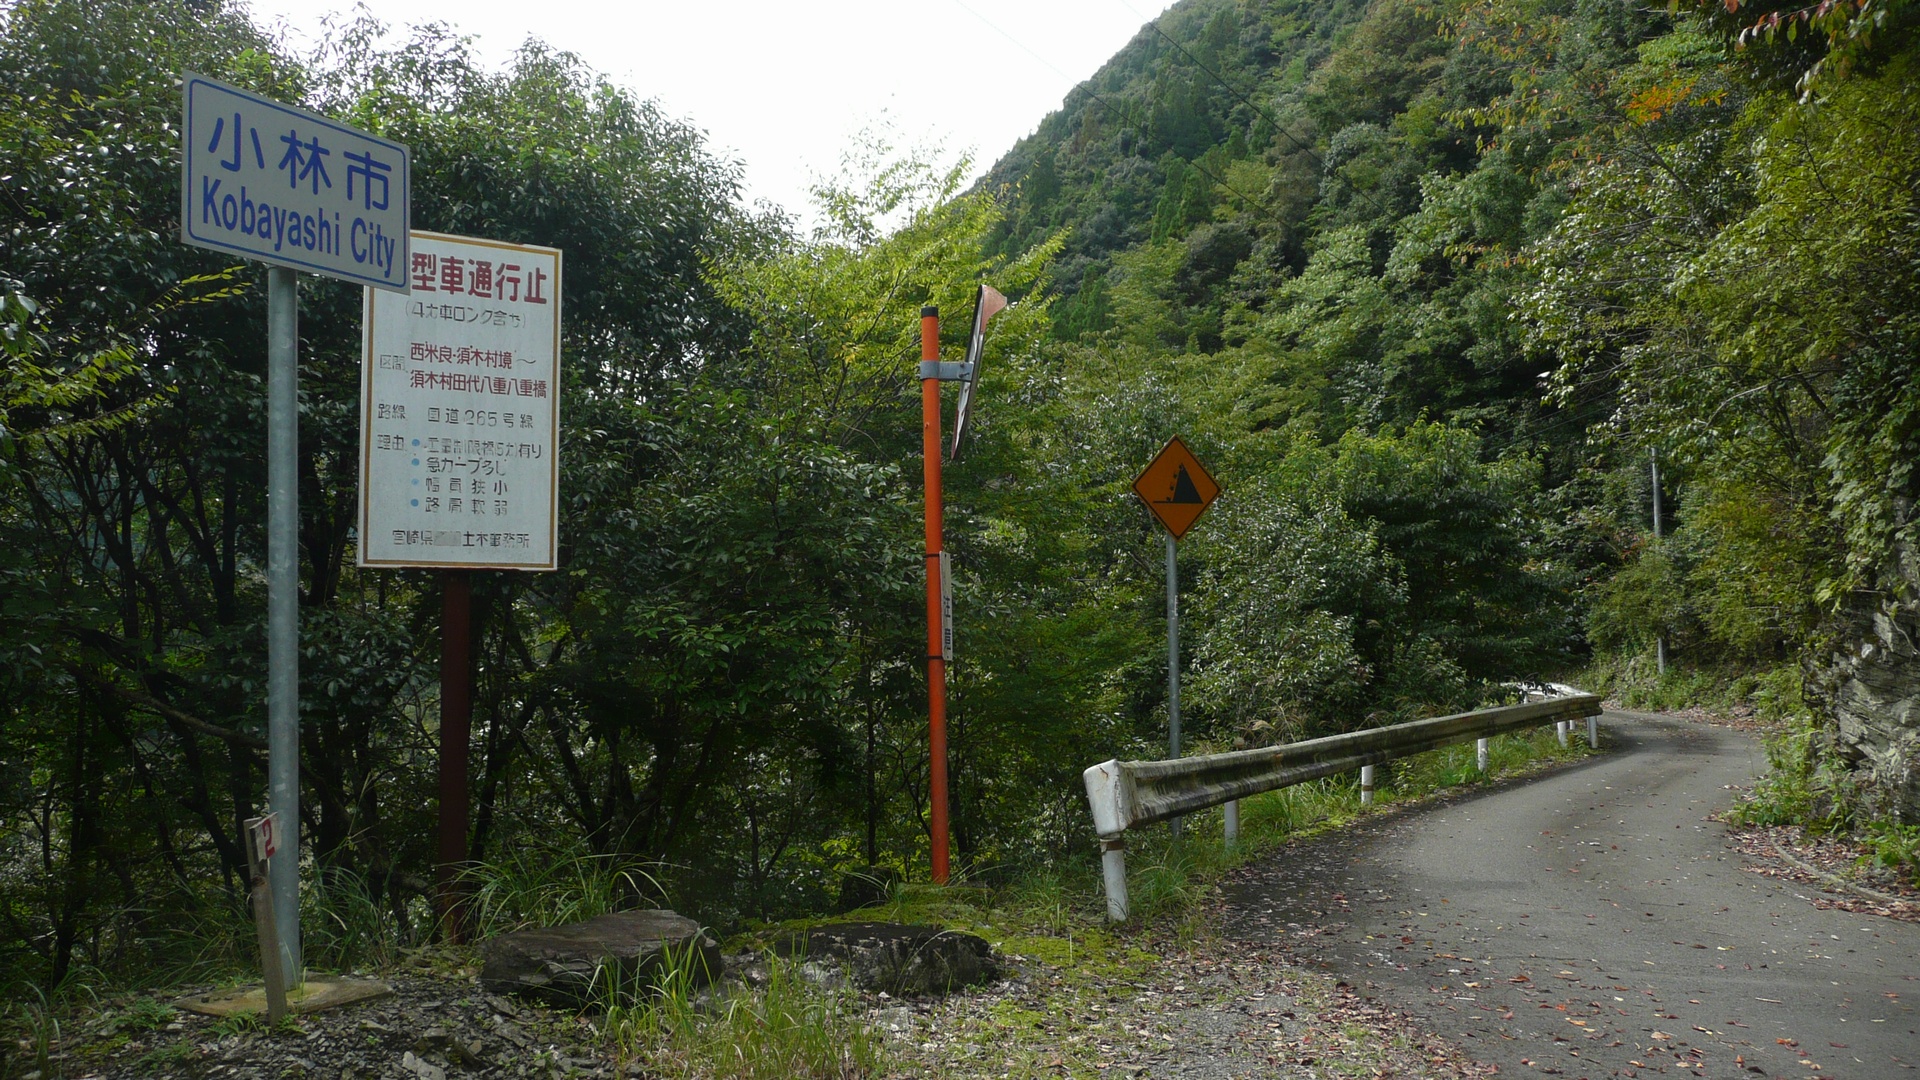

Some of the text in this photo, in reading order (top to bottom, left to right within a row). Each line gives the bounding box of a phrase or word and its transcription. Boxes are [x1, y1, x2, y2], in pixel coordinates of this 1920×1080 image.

[208, 112, 392, 211] 小林市
[203, 175, 395, 279] Kobayashi City
[411, 252, 547, 305] 型車通行止
[379, 354, 406, 371] 区間
[410, 369, 547, 398] 須木村田代八重八重橋
[377, 403, 406, 420] 路線
[427, 407, 534, 429] 国道265号線
[377, 434, 405, 451] 理由
[262, 818, 276, 858] 2
